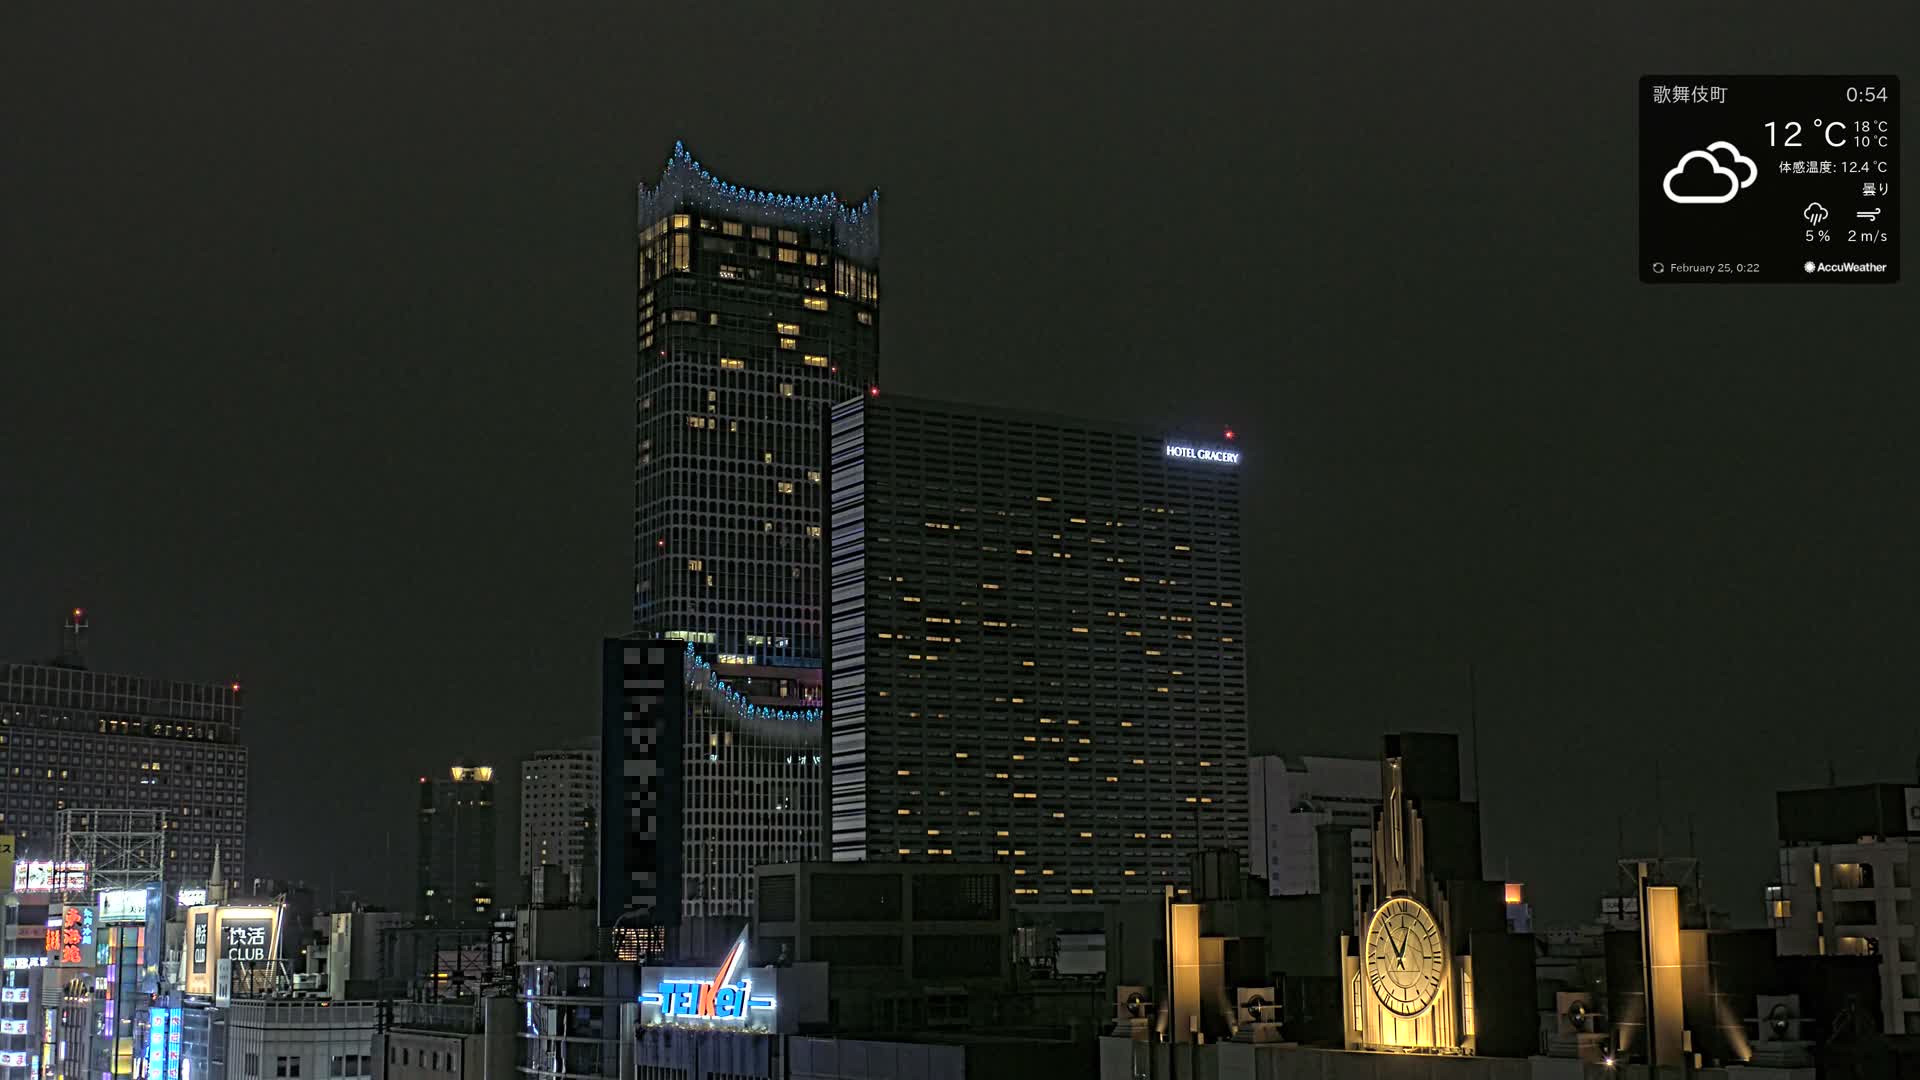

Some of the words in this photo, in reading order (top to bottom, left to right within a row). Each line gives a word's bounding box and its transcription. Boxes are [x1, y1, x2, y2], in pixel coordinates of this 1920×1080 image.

[1166, 445, 1196, 459] HOTEL
[1197, 449, 1239, 463] GRACERY
[0, 844, 11, 853] ス
[227, 927, 265, 946] 快活
[229, 948, 264, 961] CLUB
